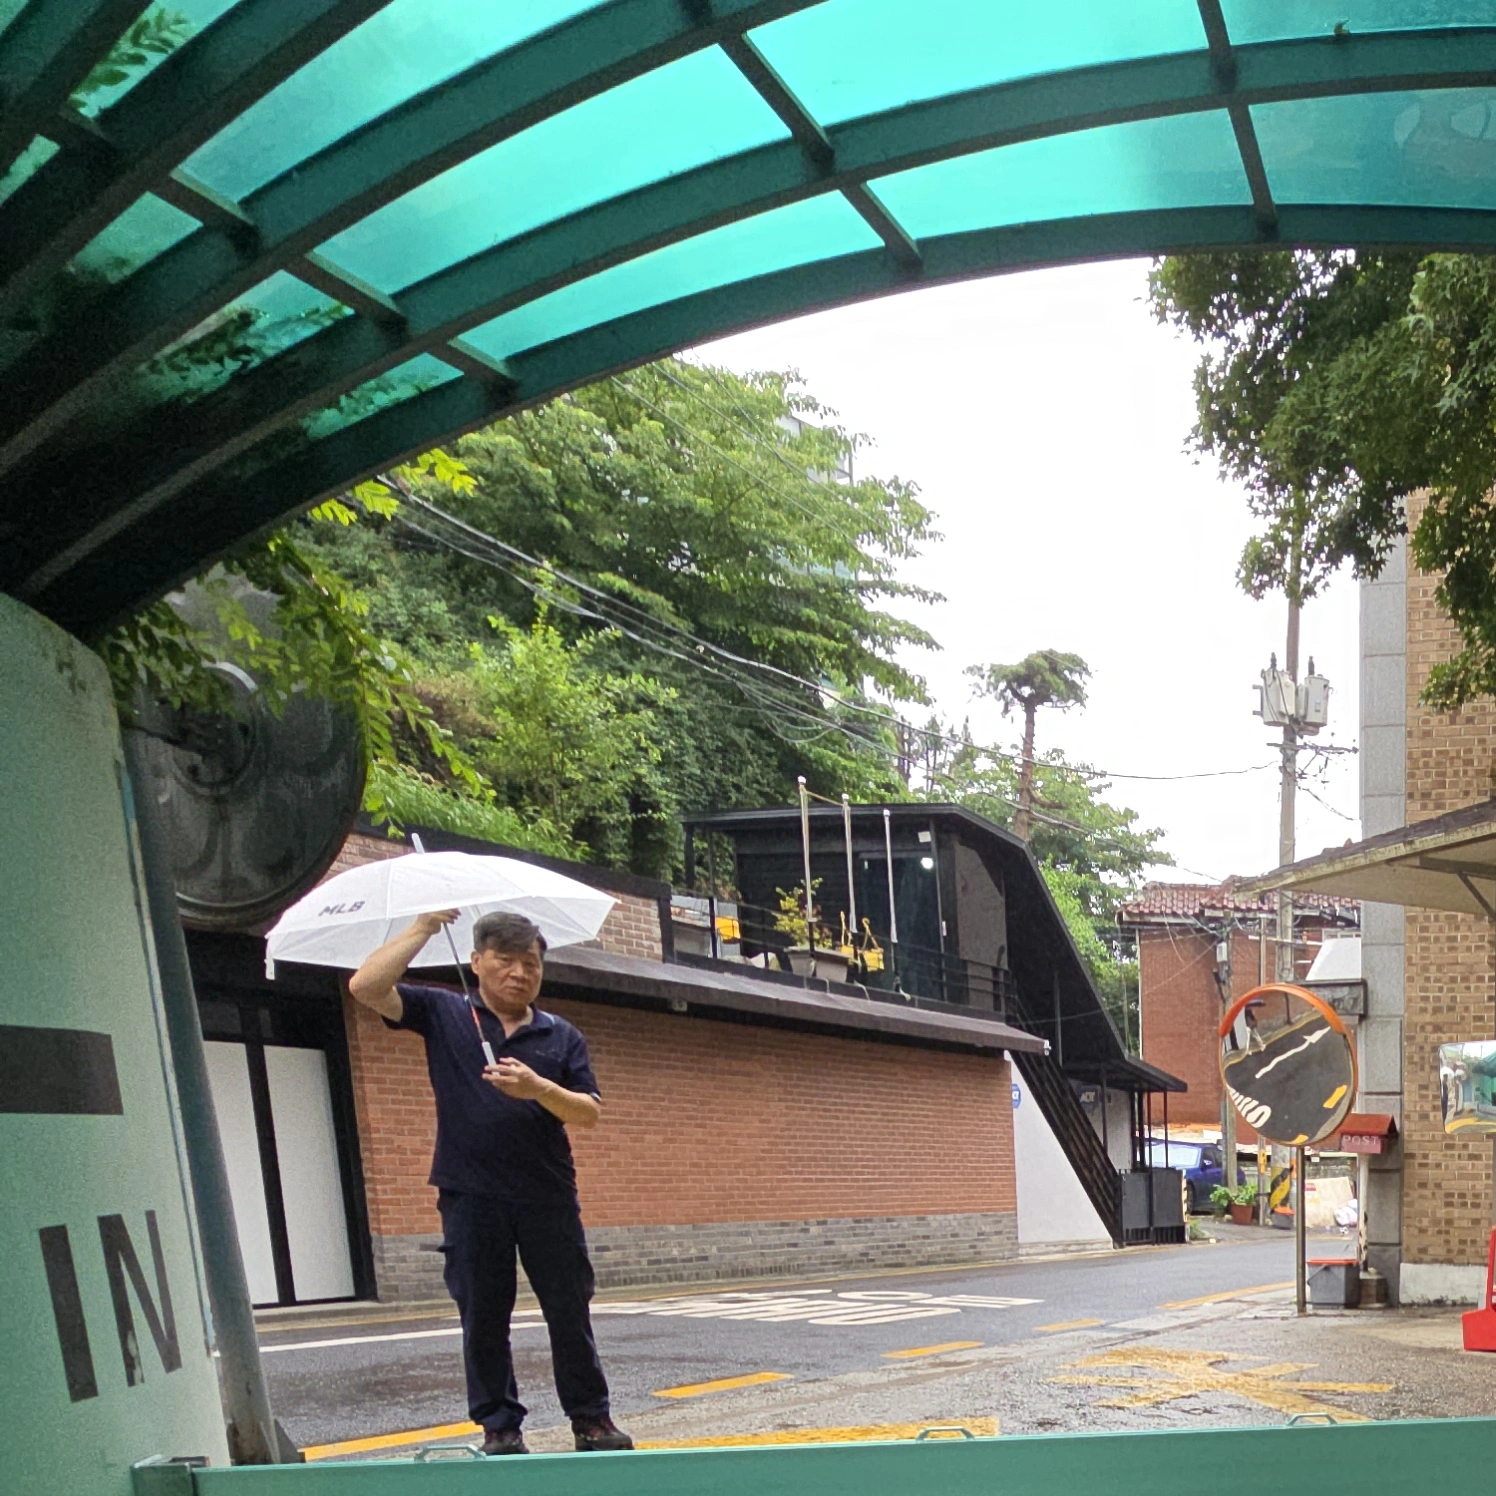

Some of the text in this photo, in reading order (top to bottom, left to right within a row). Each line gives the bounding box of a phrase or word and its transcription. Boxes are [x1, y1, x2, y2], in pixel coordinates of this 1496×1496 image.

[318, 901, 365, 917] MLB
[1341, 1134, 1379, 1148] POST
[39, 1210, 182, 1404] IN
